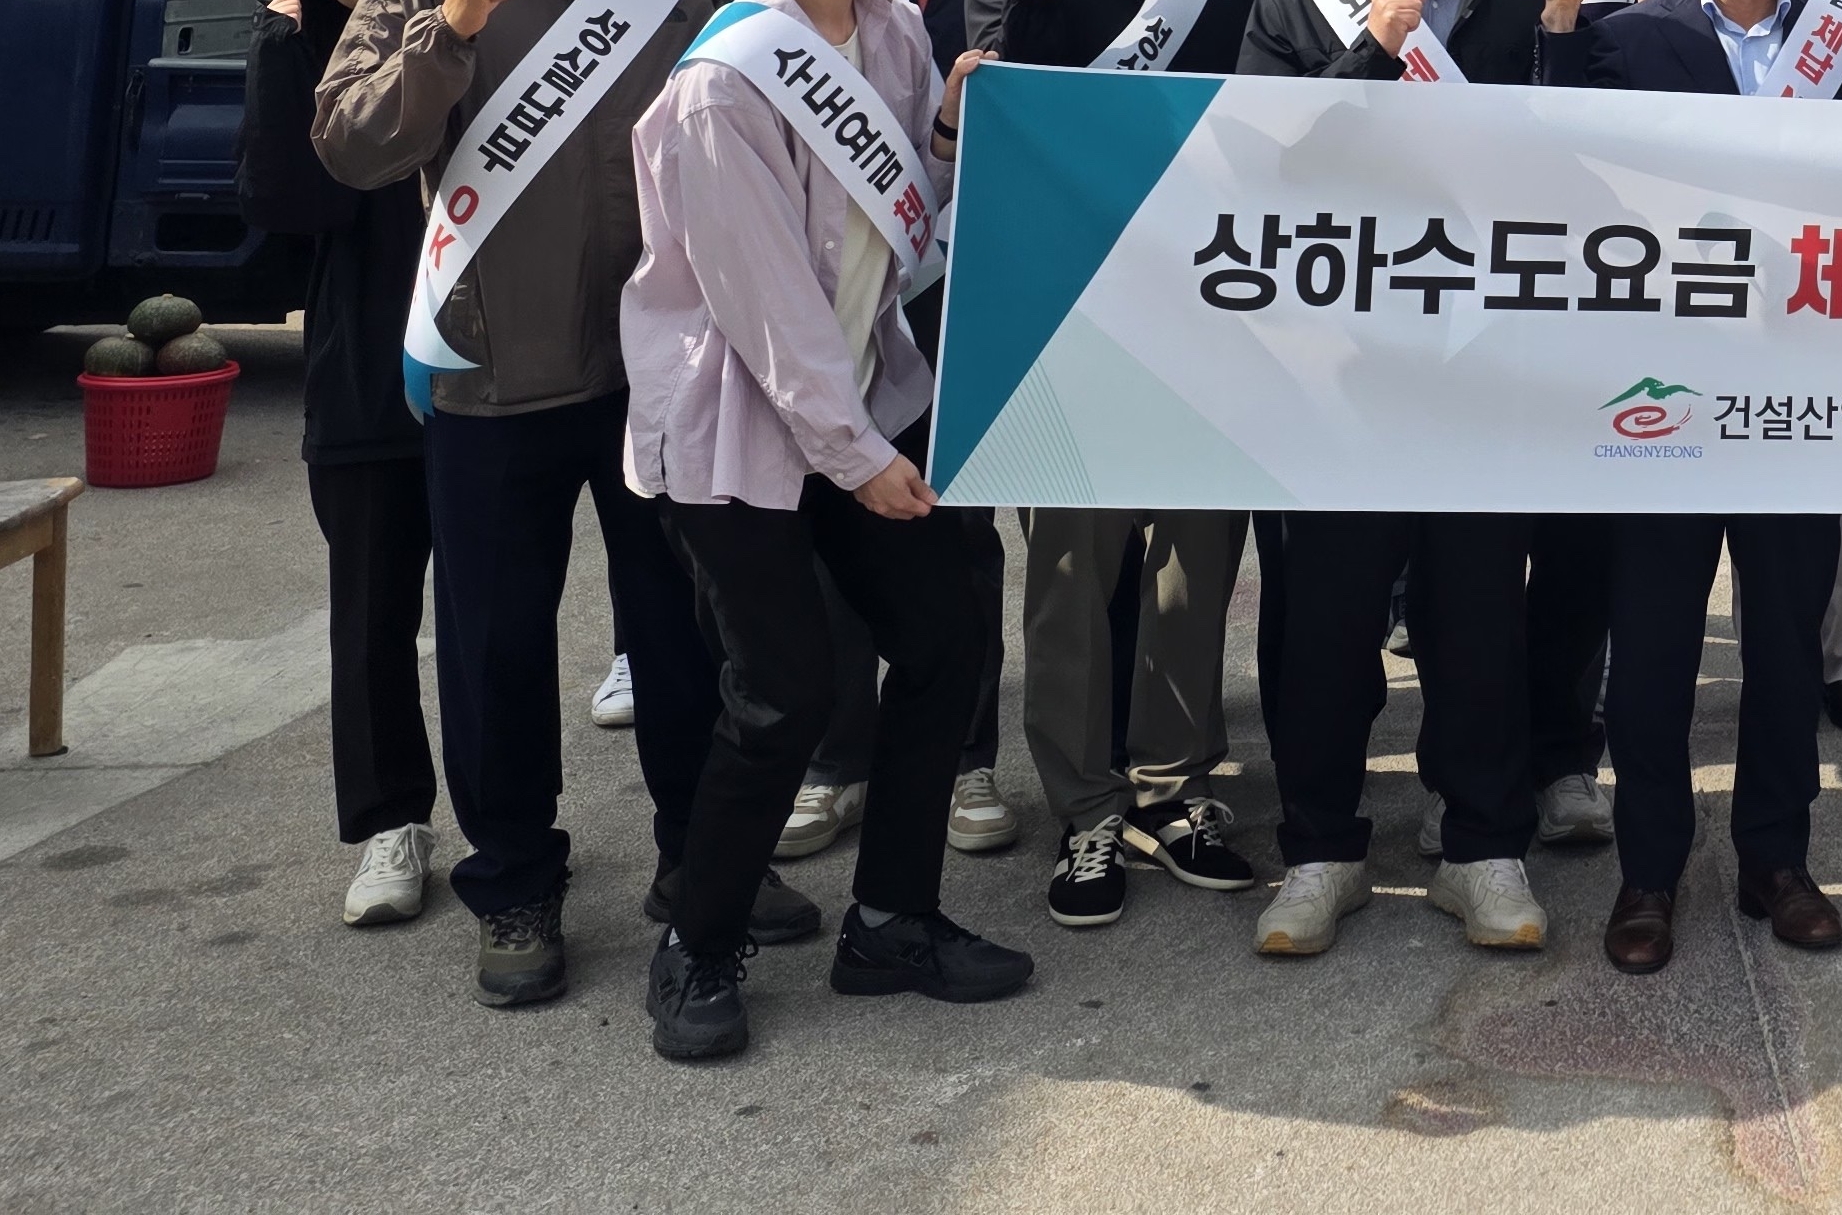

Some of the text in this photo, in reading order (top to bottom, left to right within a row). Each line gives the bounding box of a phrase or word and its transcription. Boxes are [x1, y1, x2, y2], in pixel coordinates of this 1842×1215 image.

[476, 8, 631, 172] 성실납부
[773, 47, 904, 195] 수도요금
[428, 184, 480, 272] OK
[1193, 211, 1757, 320] 상하수도요금
[1594, 445, 1704, 460] CHANGNYEONG
